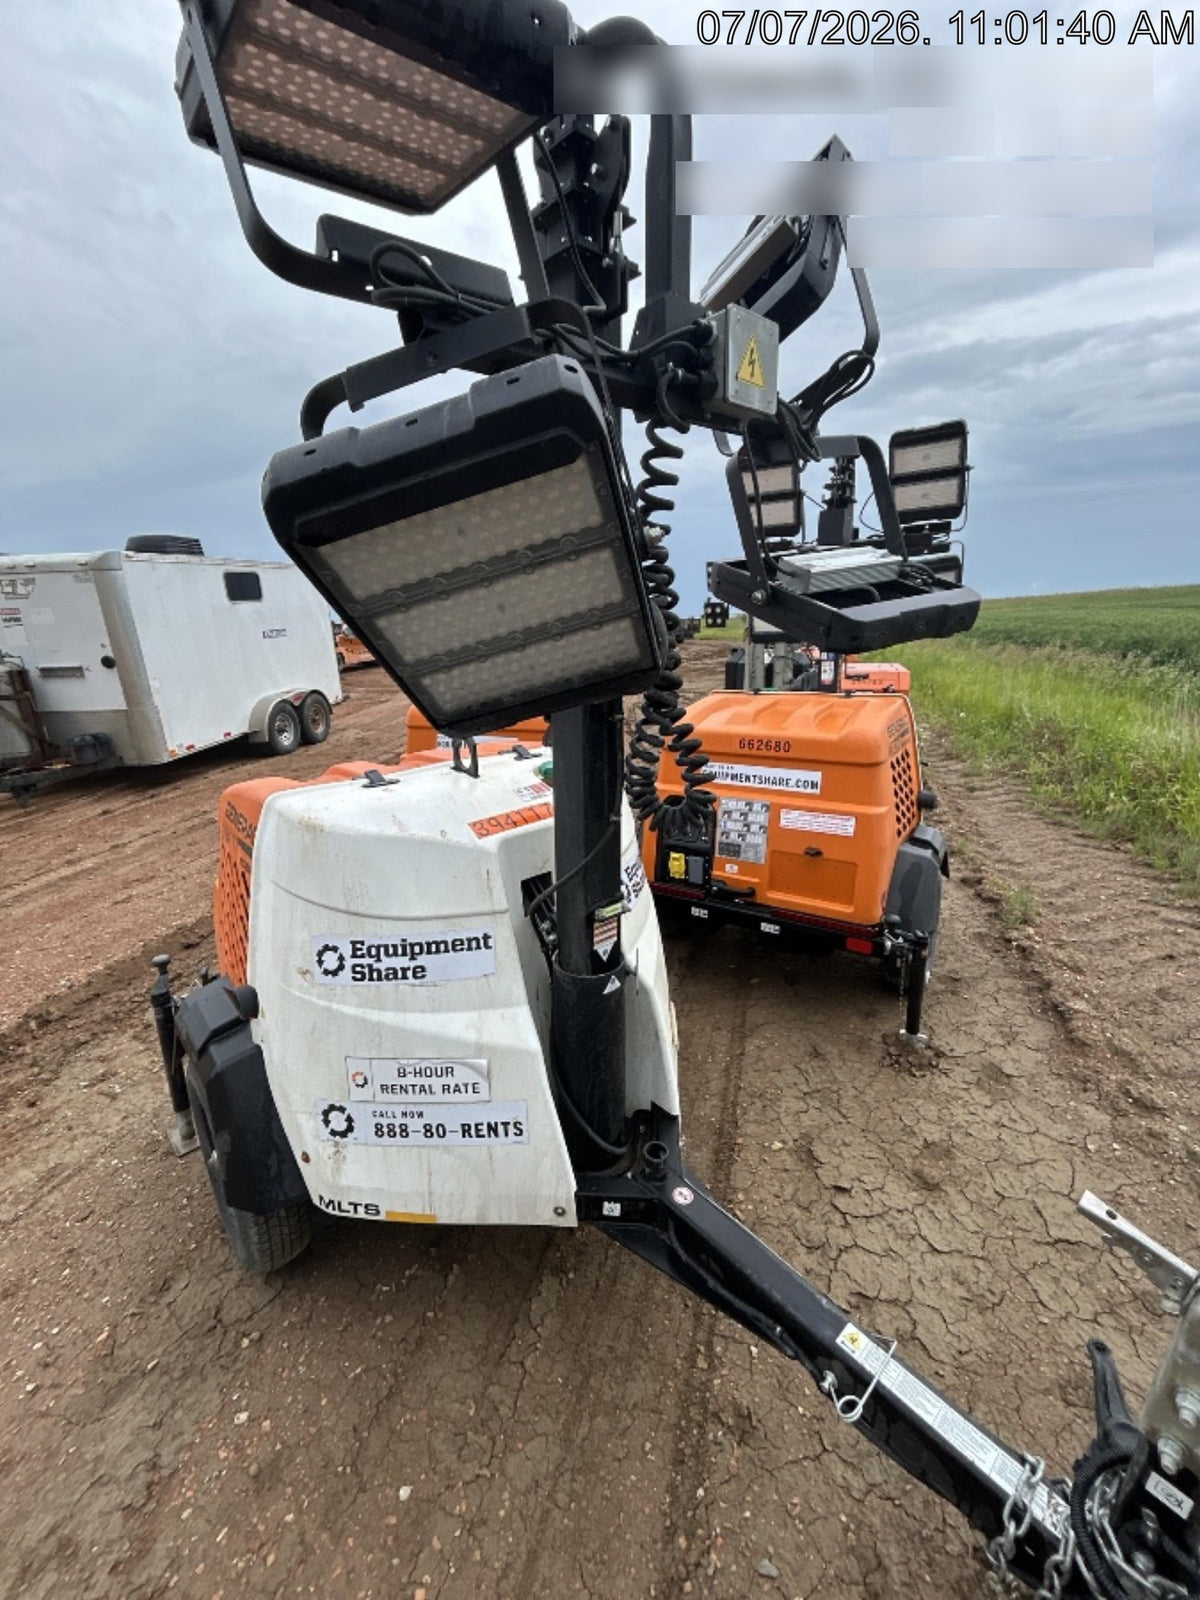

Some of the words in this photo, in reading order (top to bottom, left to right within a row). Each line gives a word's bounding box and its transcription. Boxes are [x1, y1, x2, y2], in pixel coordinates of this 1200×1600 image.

[739, 738, 792, 753] 662680
[703, 769, 819, 790] UIPMENTSHARE.COM
[472, 802, 553, 837] 394117
[350, 932, 492, 962] Equipment
[351, 963, 427, 983] Share
[380, 1084, 436, 1096] RENTAL
[441, 1082, 481, 1095] RATE
[372, 1110, 397, 1119] CALL
[401, 1110, 425, 1119] NOW
[374, 1121, 524, 1139] 888-80-RENTS
[318, 1194, 381, 1216] MLTS
